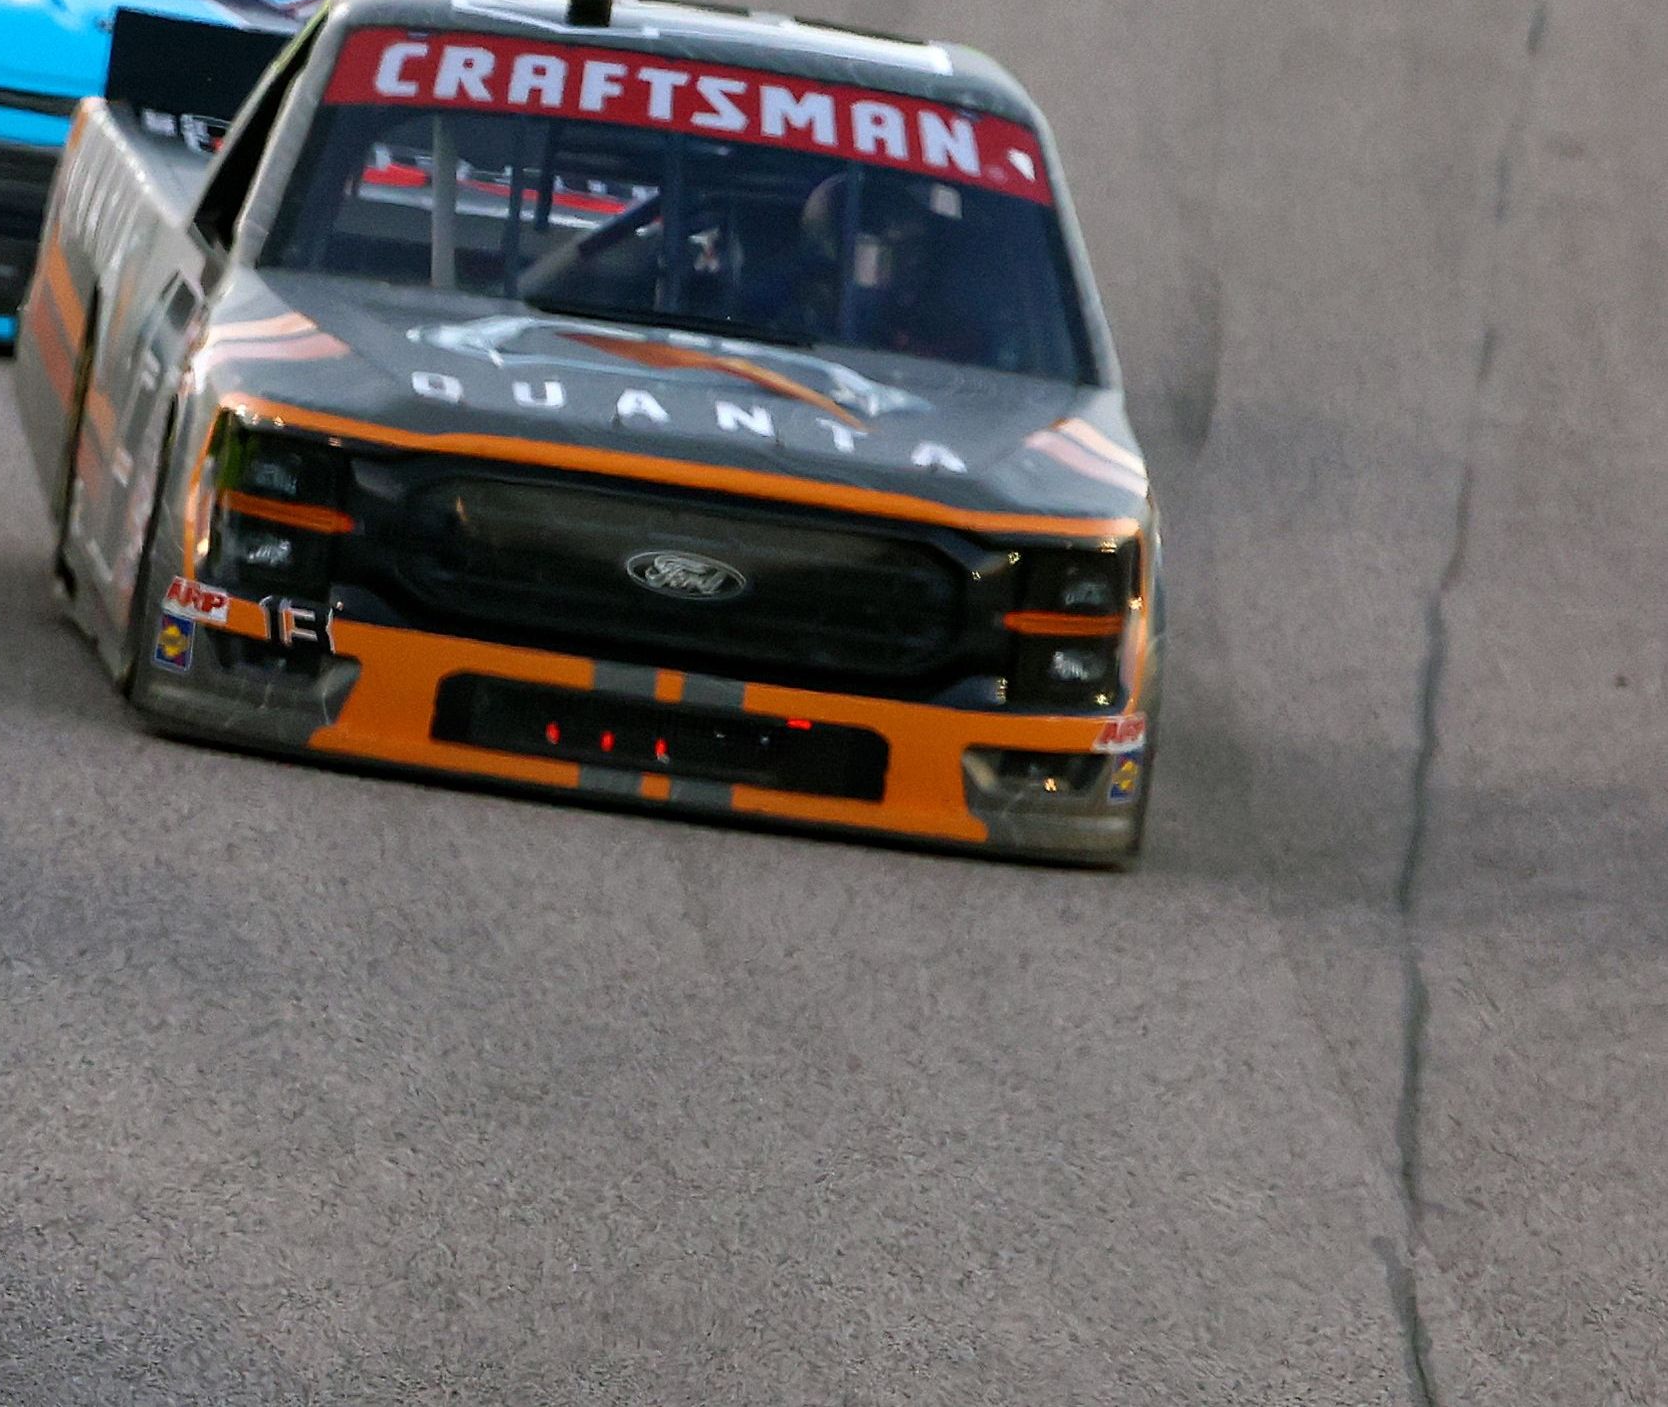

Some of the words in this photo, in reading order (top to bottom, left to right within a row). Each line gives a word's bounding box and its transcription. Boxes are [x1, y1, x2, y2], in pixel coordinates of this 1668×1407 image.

[375, 42, 980, 176] CRAFTSMAN
[411, 370, 968, 474] QUANTA
[644, 554, 726, 595] Ford
